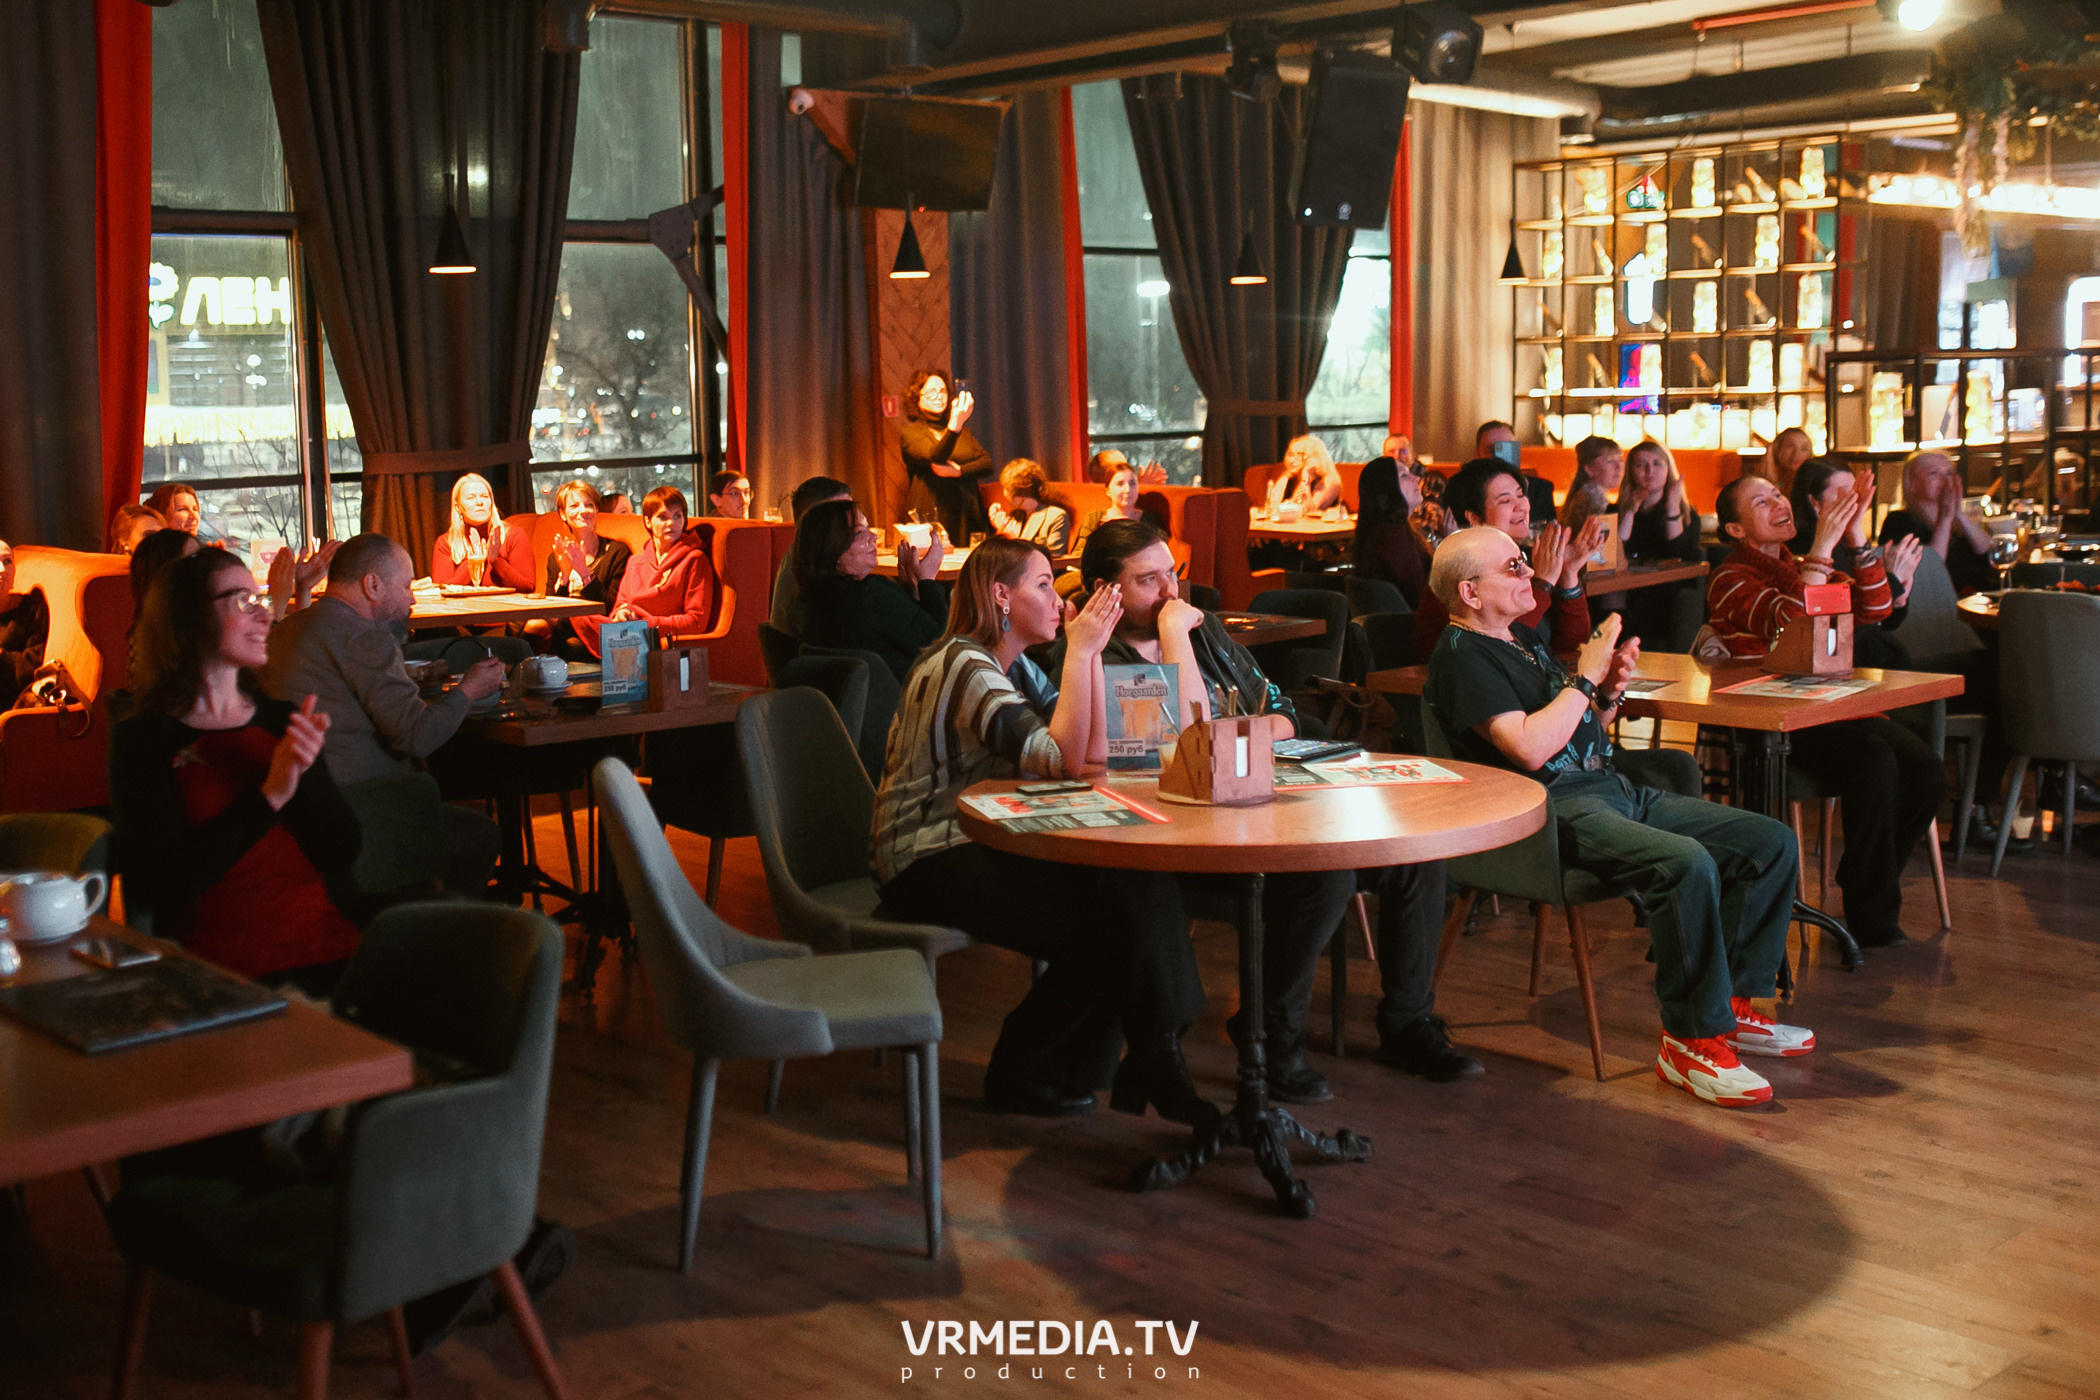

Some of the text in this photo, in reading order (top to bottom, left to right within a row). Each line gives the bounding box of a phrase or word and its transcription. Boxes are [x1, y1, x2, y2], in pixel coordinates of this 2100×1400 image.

[1115, 685, 1168, 698] Hoegaarden
[1109, 745, 1144, 755] 250 руб
